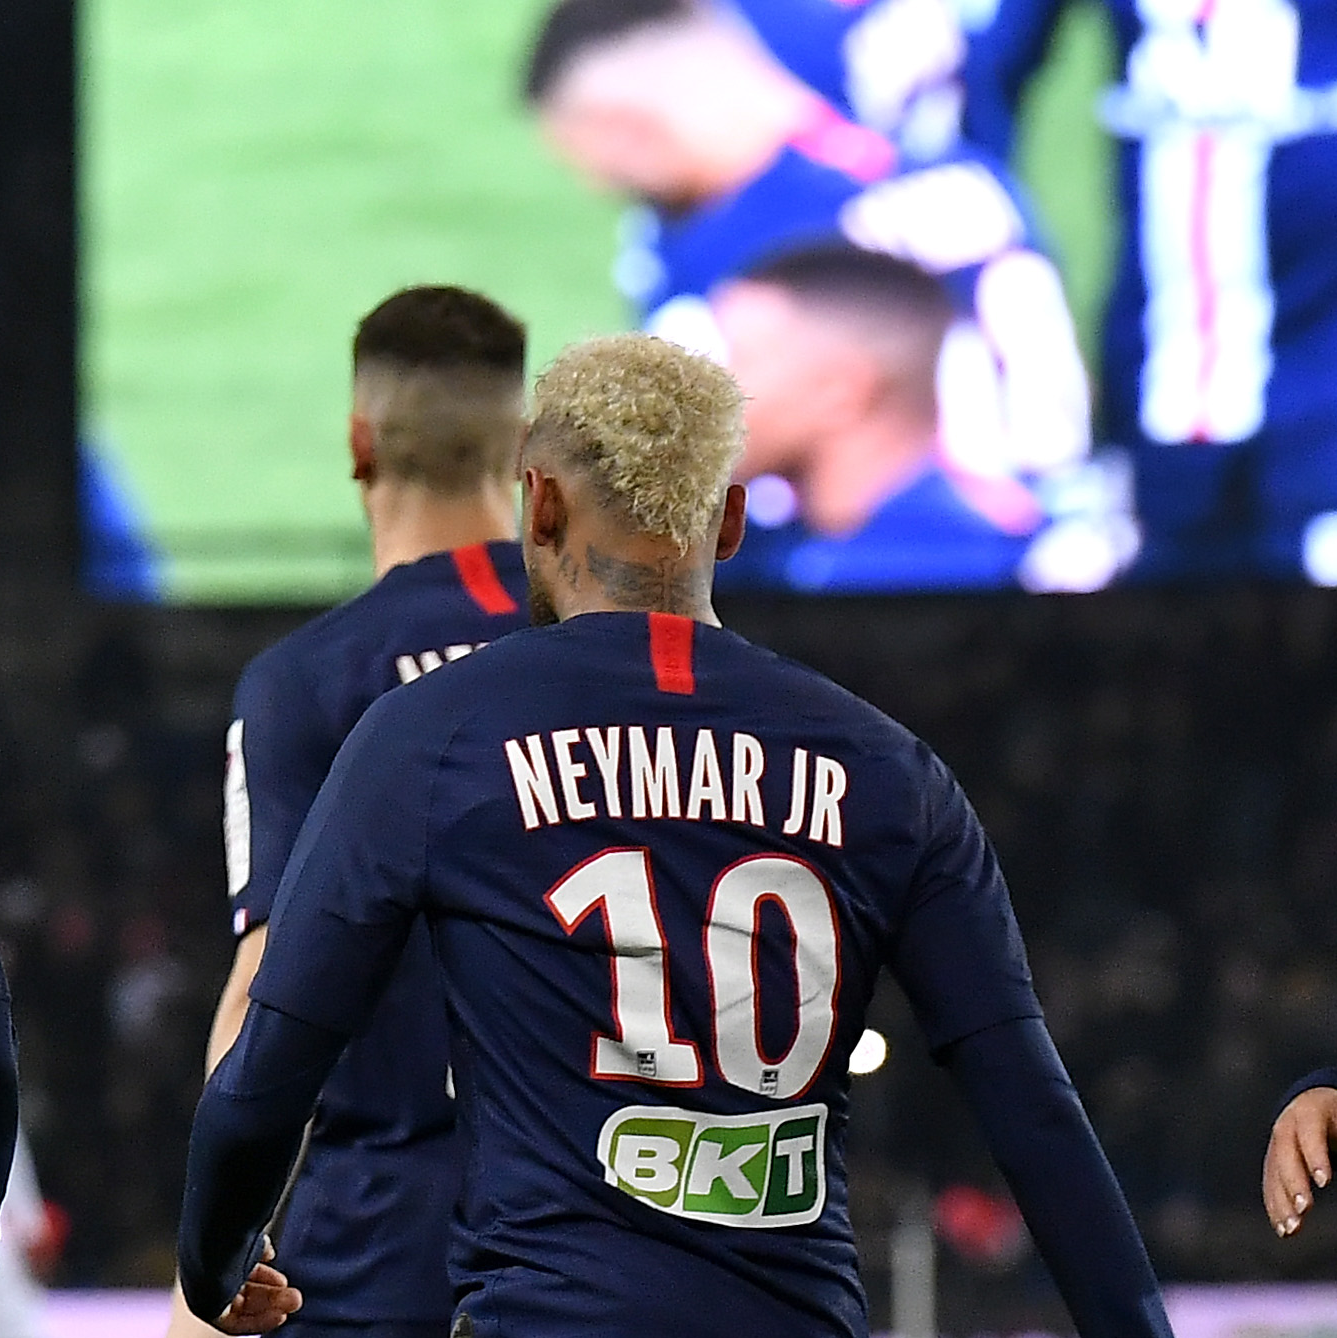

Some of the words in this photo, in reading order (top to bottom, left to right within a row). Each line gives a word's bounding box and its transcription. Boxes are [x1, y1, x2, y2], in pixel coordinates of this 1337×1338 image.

[504, 726, 766, 831] NEYMAR
[782, 747, 848, 848] JR
[543, 846, 841, 1100] 10
[613, 1132, 815, 1201] BKT
